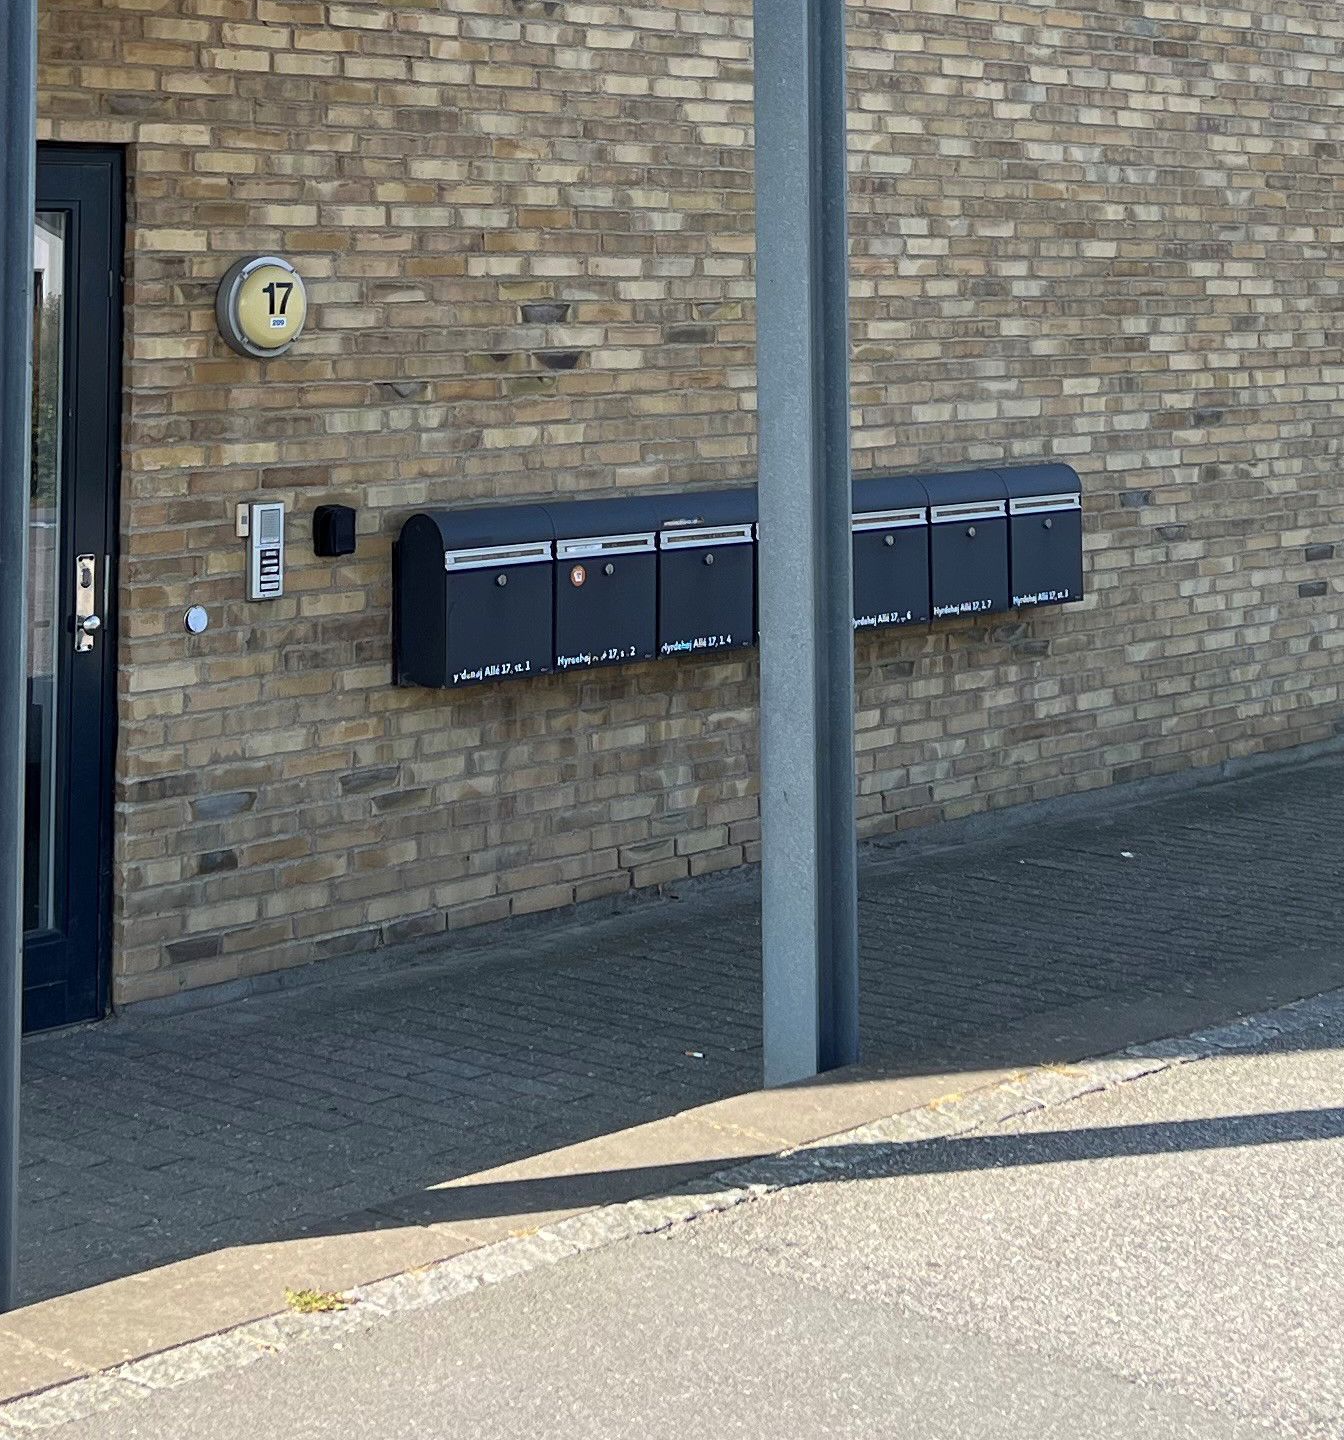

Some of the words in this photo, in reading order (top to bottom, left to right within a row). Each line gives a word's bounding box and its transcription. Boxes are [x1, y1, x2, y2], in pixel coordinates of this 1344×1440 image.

[262, 282, 294, 315] 17
[906, 610, 912, 620] 6
[726, 634, 732, 644] 4
[608, 648, 620, 661] 17,
[630, 645, 636, 657] 2
[500, 663, 514, 675] 17,
[525, 660, 531, 671] 1
